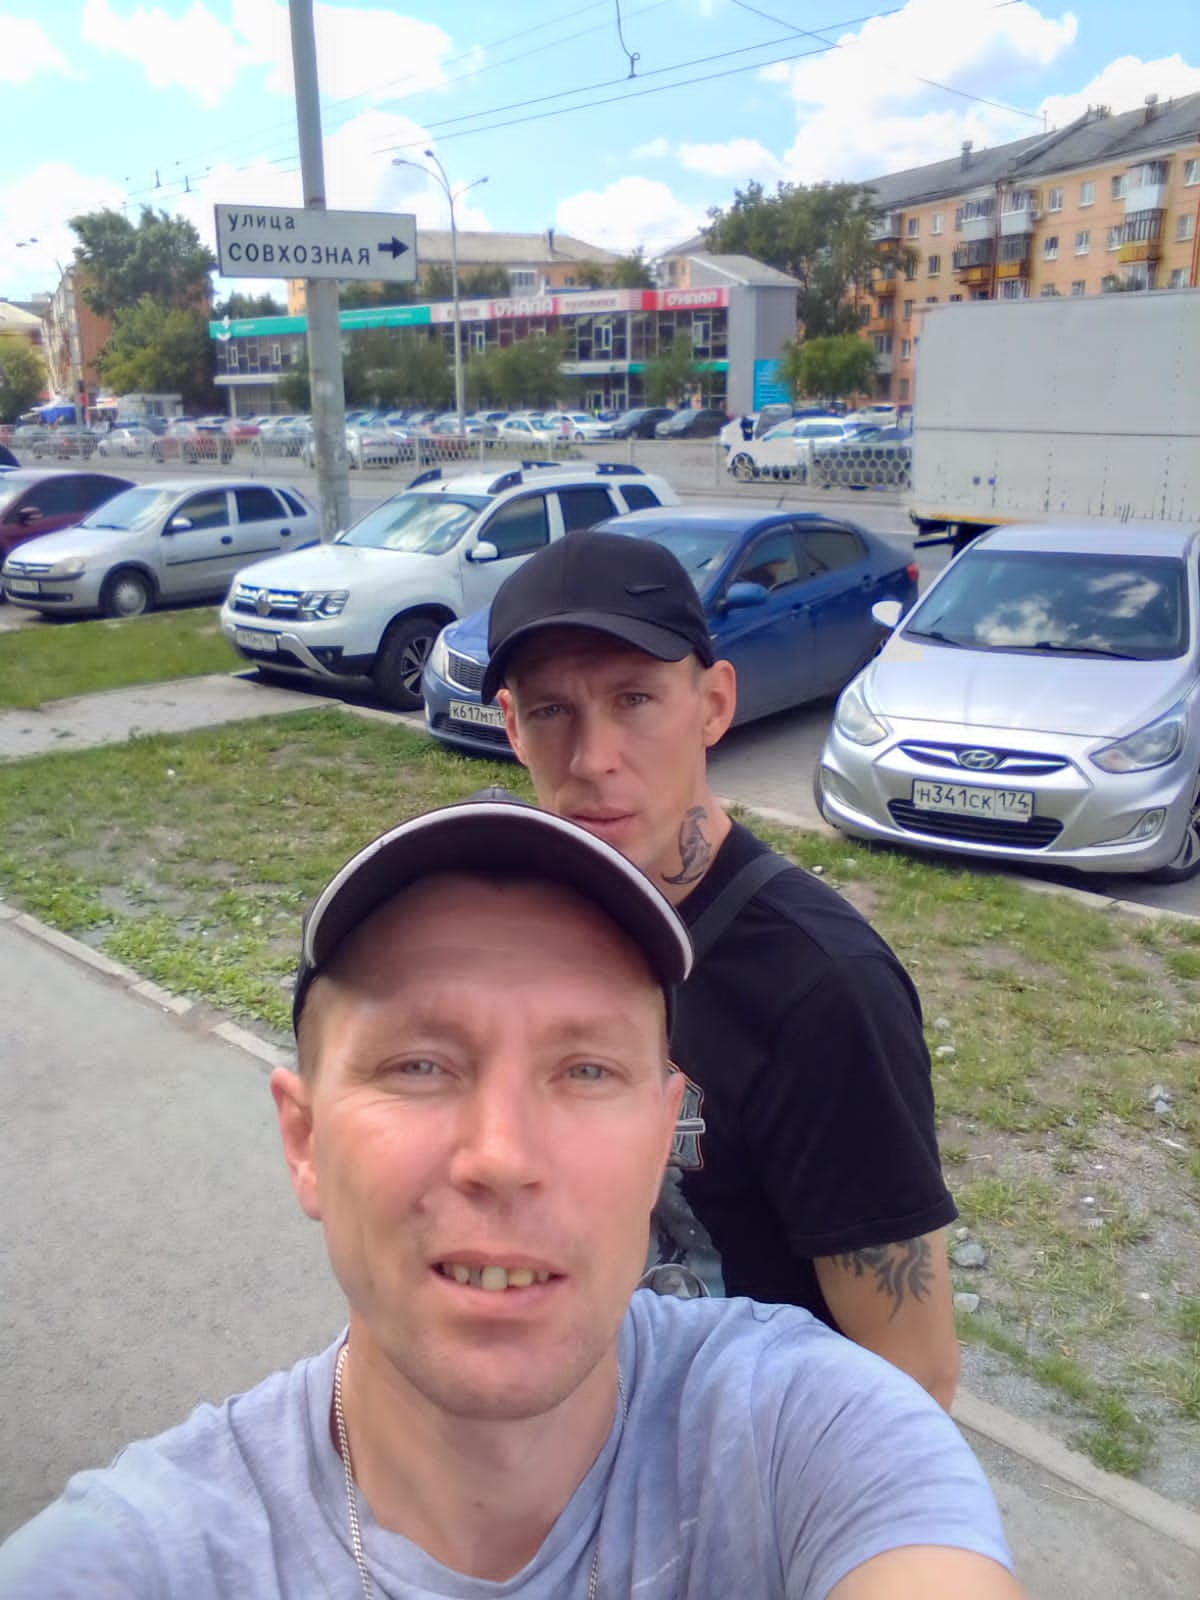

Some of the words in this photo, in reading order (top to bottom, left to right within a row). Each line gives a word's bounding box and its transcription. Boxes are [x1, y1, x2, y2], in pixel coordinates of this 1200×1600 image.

[228, 213, 296, 232] улица
[228, 243, 370, 265] СОВХОЗНАЯ
[998, 791, 1029, 809] 174
